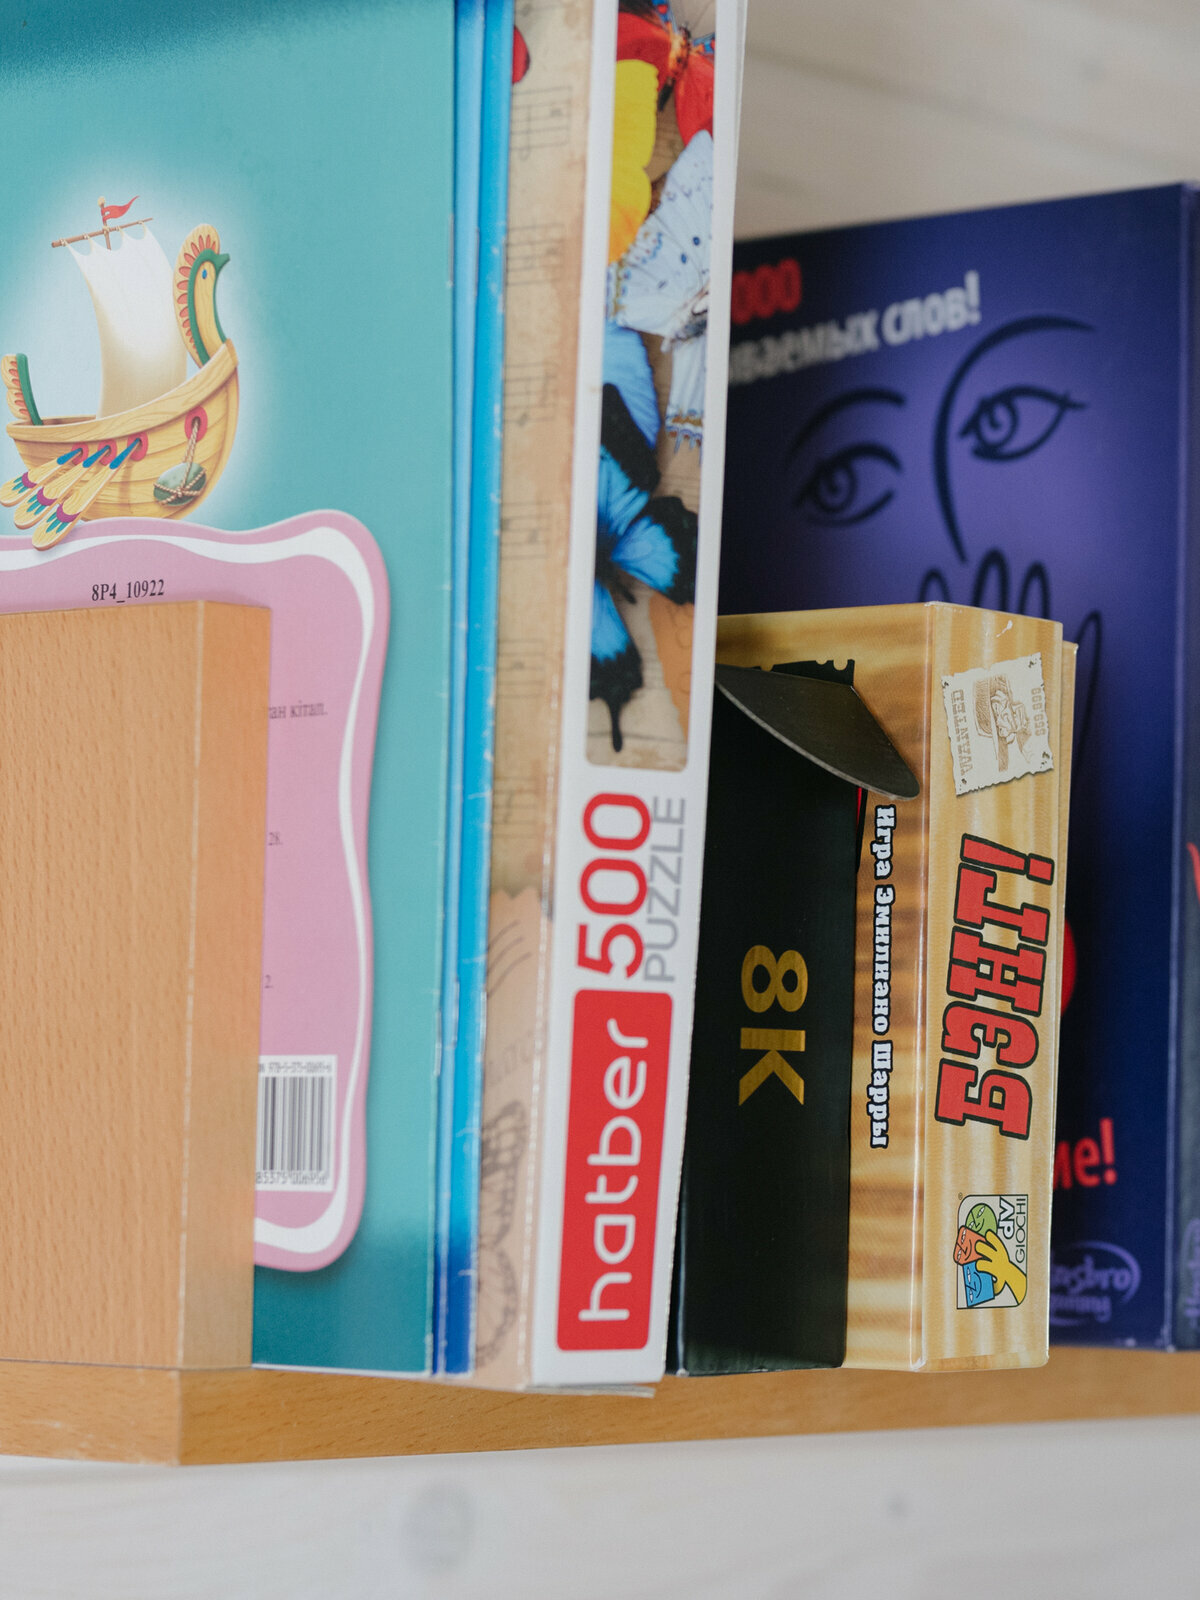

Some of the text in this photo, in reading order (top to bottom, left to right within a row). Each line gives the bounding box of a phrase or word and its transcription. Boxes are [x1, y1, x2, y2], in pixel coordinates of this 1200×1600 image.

[883, 271, 981, 346] слов!
[91, 578, 165, 604] 8P4_10922
[950, 688, 974, 776] WANTED
[576, 792, 653, 979] 500
[643, 795, 687, 985] PUZZLE
[739, 944, 810, 1106] 8K
[867, 805, 896, 1148] Игра Эмилиано Шарры
[935, 832, 1056, 1141] БЭНГ!
[578, 1018, 649, 1323] hatber
[1015, 1198, 1027, 1264] GIOCHI
